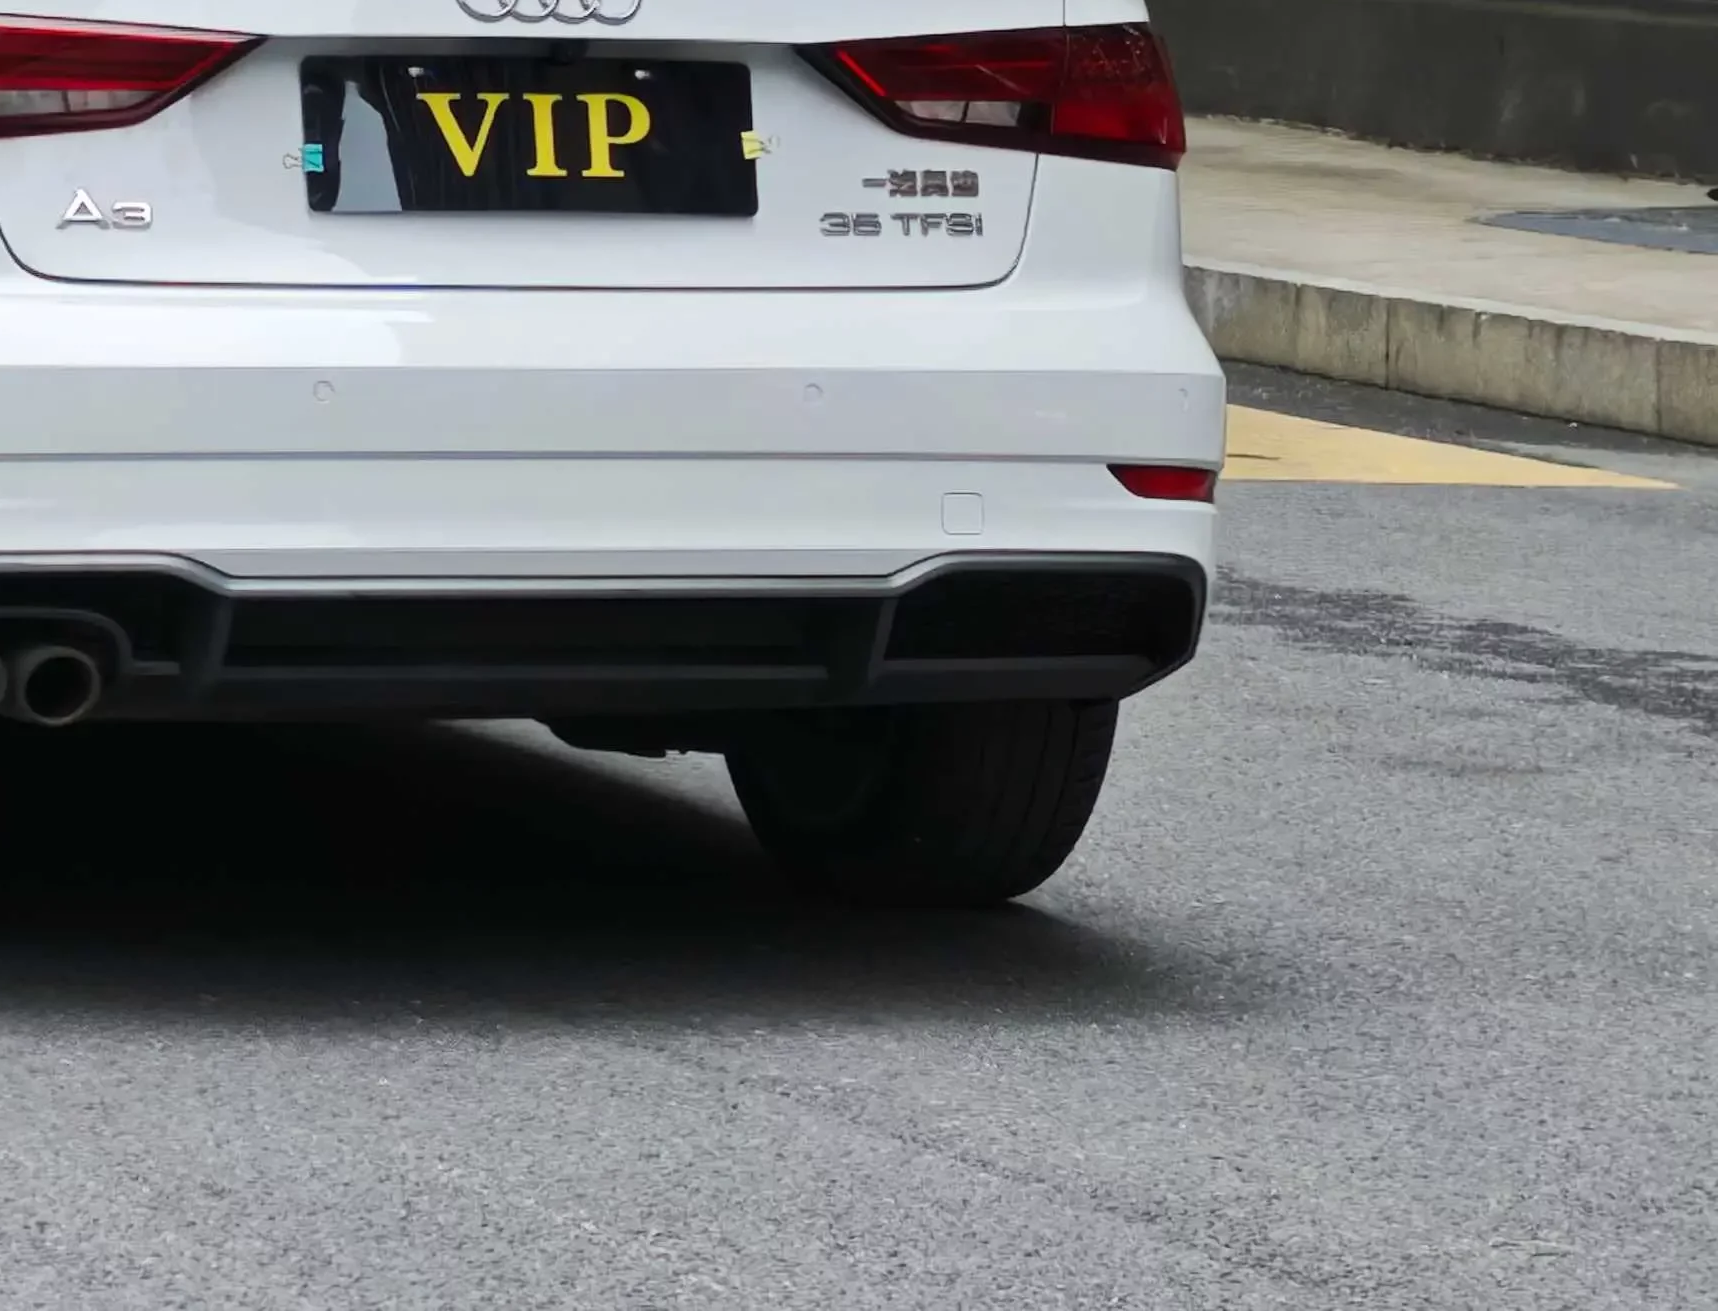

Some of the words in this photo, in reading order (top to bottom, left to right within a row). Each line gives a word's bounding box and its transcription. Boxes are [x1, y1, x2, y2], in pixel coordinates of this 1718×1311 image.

[417, 93, 650, 177] VIP
[56, 187, 153, 230] A3
[820, 213, 882, 236] 35
[890, 213, 984, 236] TFSI
